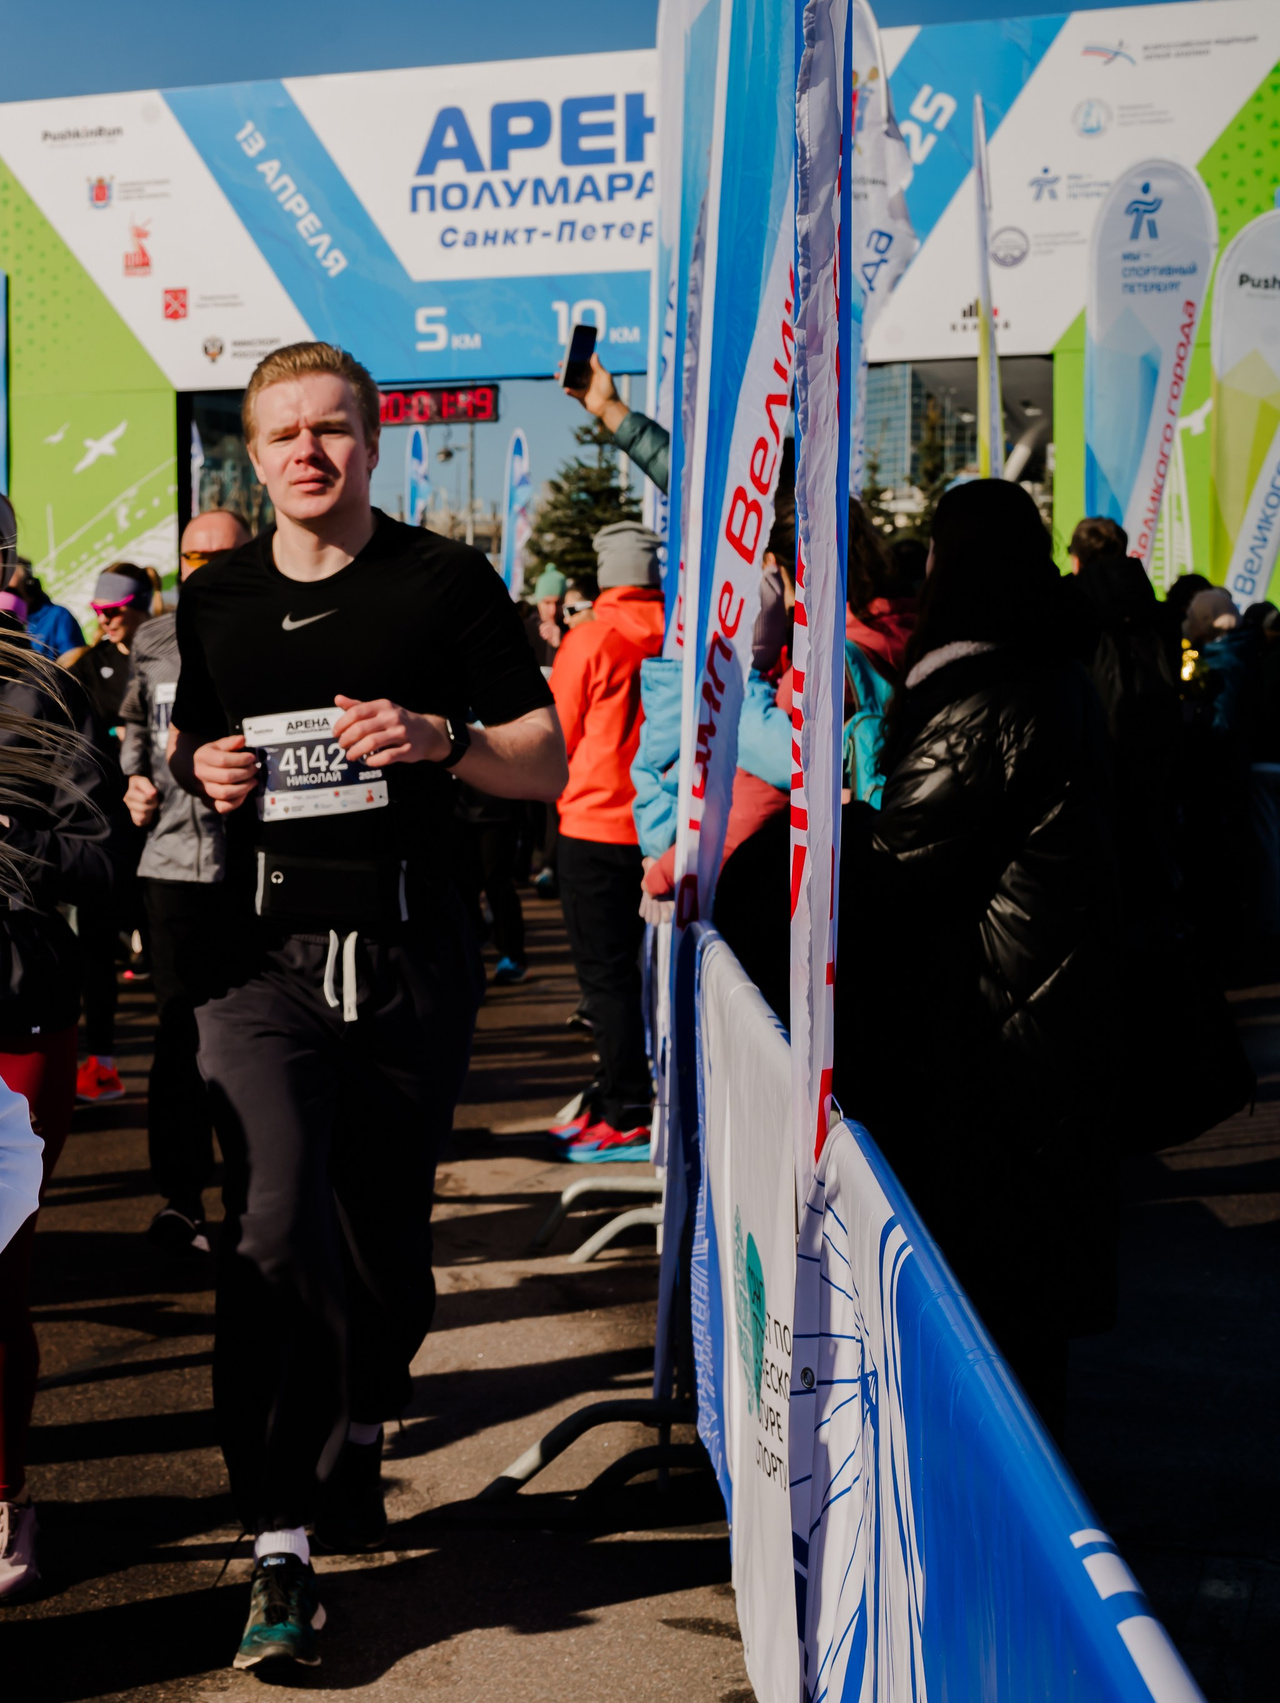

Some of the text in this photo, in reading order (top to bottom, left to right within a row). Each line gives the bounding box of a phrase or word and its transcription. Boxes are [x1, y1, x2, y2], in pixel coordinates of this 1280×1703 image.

[41, 124, 124, 142] PushkinRun
[415, 92, 655, 177] АРЕН
[235, 119, 350, 279] 13 АПРЕЛЯ
[409, 170, 654, 214] ПОЛУМАРА
[439, 219, 654, 250] Санкт-Петер
[414, 305, 449, 352] 5
[551, 298, 607, 347] 10
[1165, 299, 1197, 418] города
[286, 717, 330, 731] АРЕНА
[278, 742, 349, 776] 4142
[286, 769, 342, 787] НИКОЛАЙ
[773, 1318, 792, 1358] ПО
